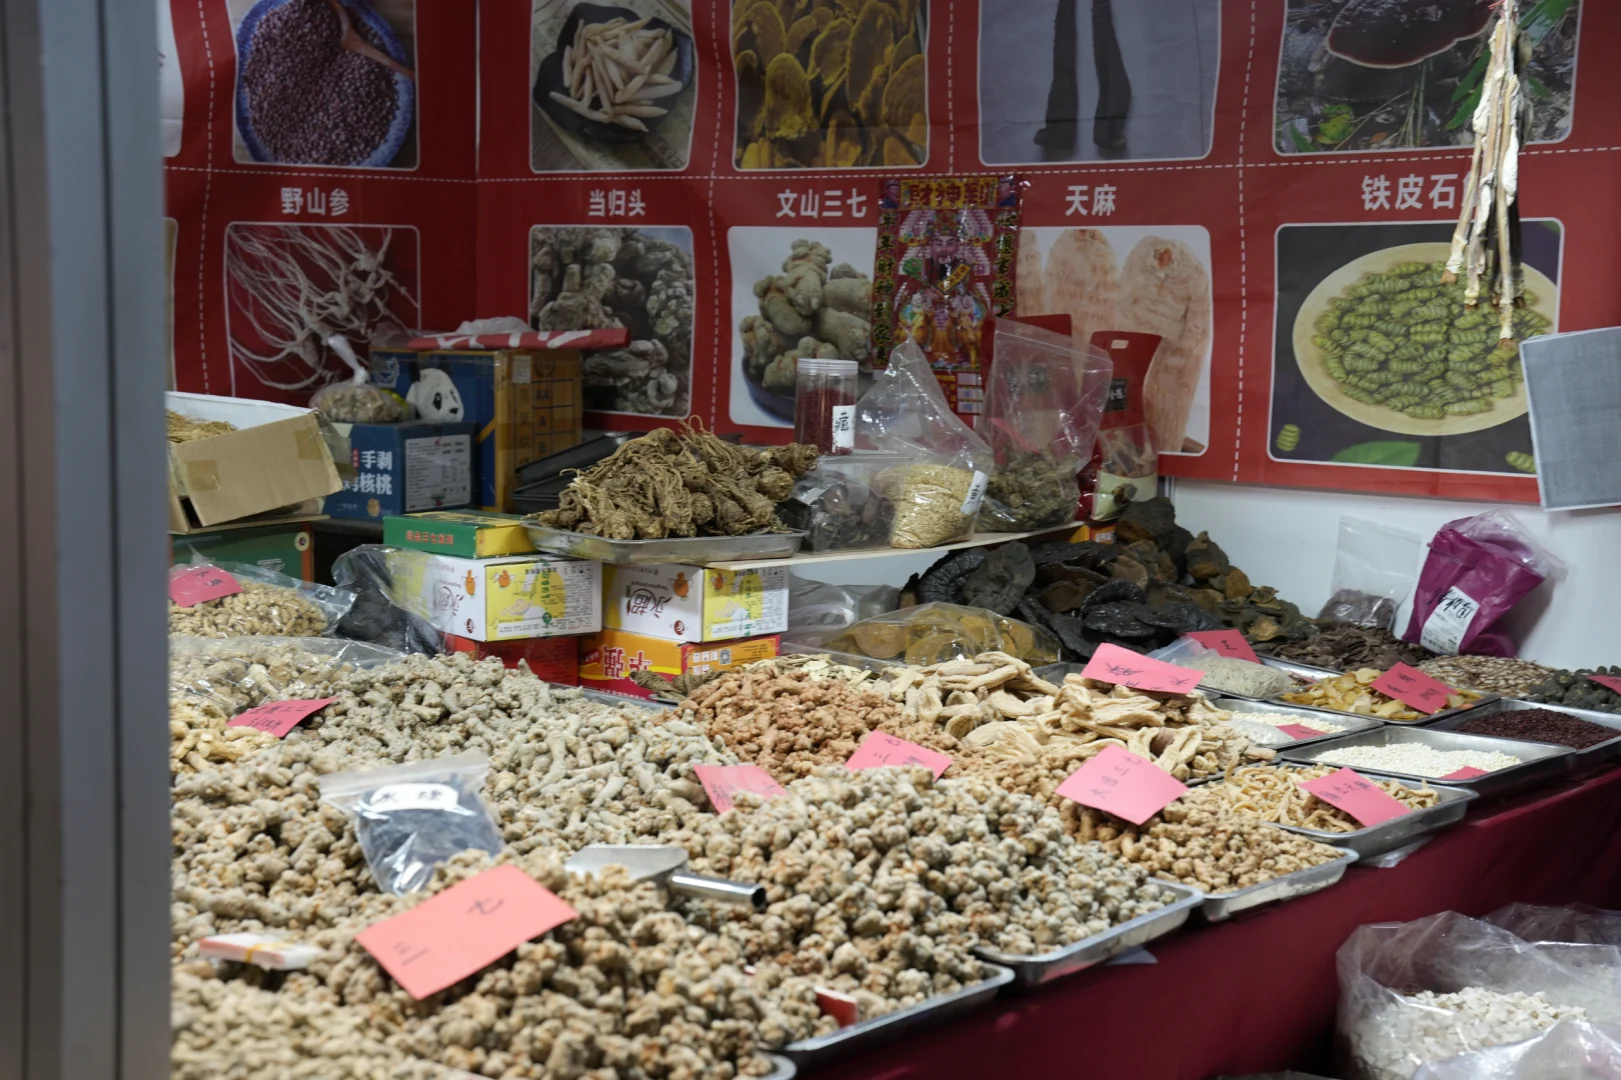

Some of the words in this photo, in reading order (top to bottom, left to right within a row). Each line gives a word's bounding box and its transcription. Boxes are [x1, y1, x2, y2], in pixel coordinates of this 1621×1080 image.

[280, 187, 350, 216] 野山参
[588, 190, 646, 217] 当归头
[775, 188, 868, 219] 文山三七
[1065, 184, 1117, 217] 天麻
[361, 450, 393, 470] 手剥
